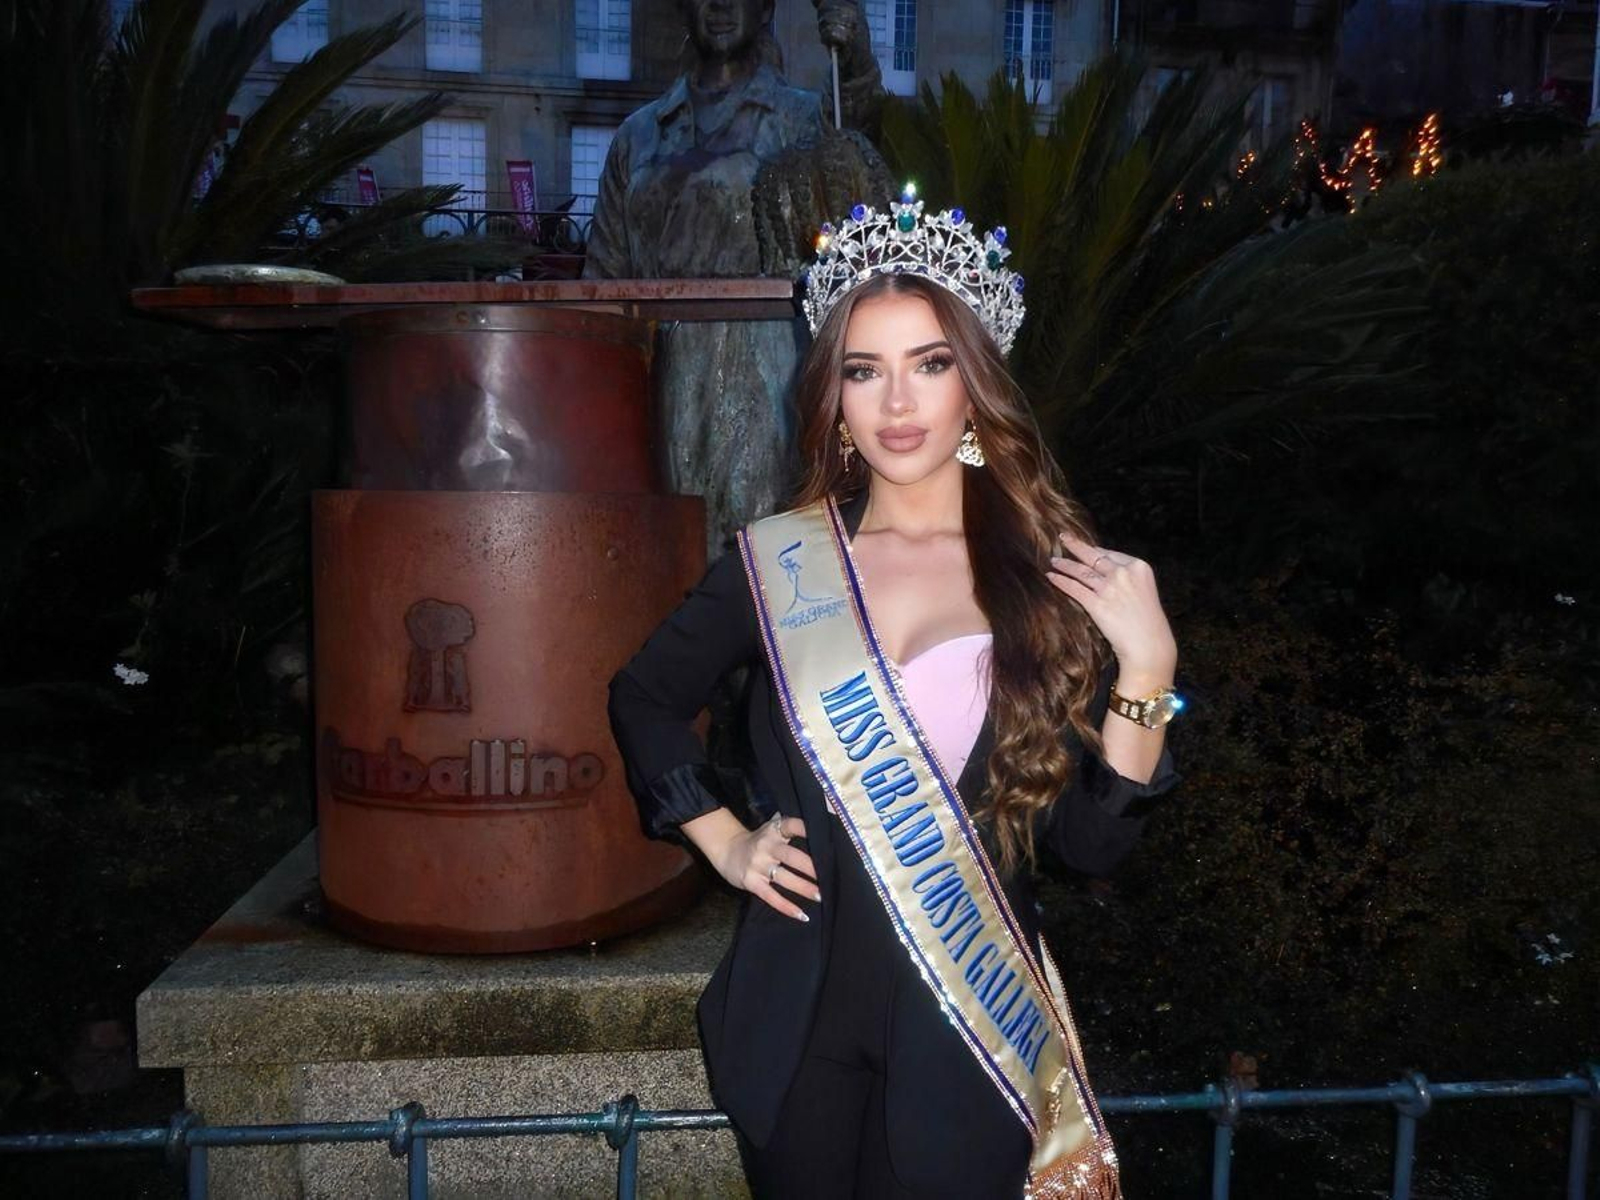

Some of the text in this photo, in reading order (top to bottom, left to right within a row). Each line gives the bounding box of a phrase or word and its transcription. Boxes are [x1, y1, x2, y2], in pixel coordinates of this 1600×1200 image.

[819, 670, 1050, 1076] MISS GRAND COSTA GALLEGA
